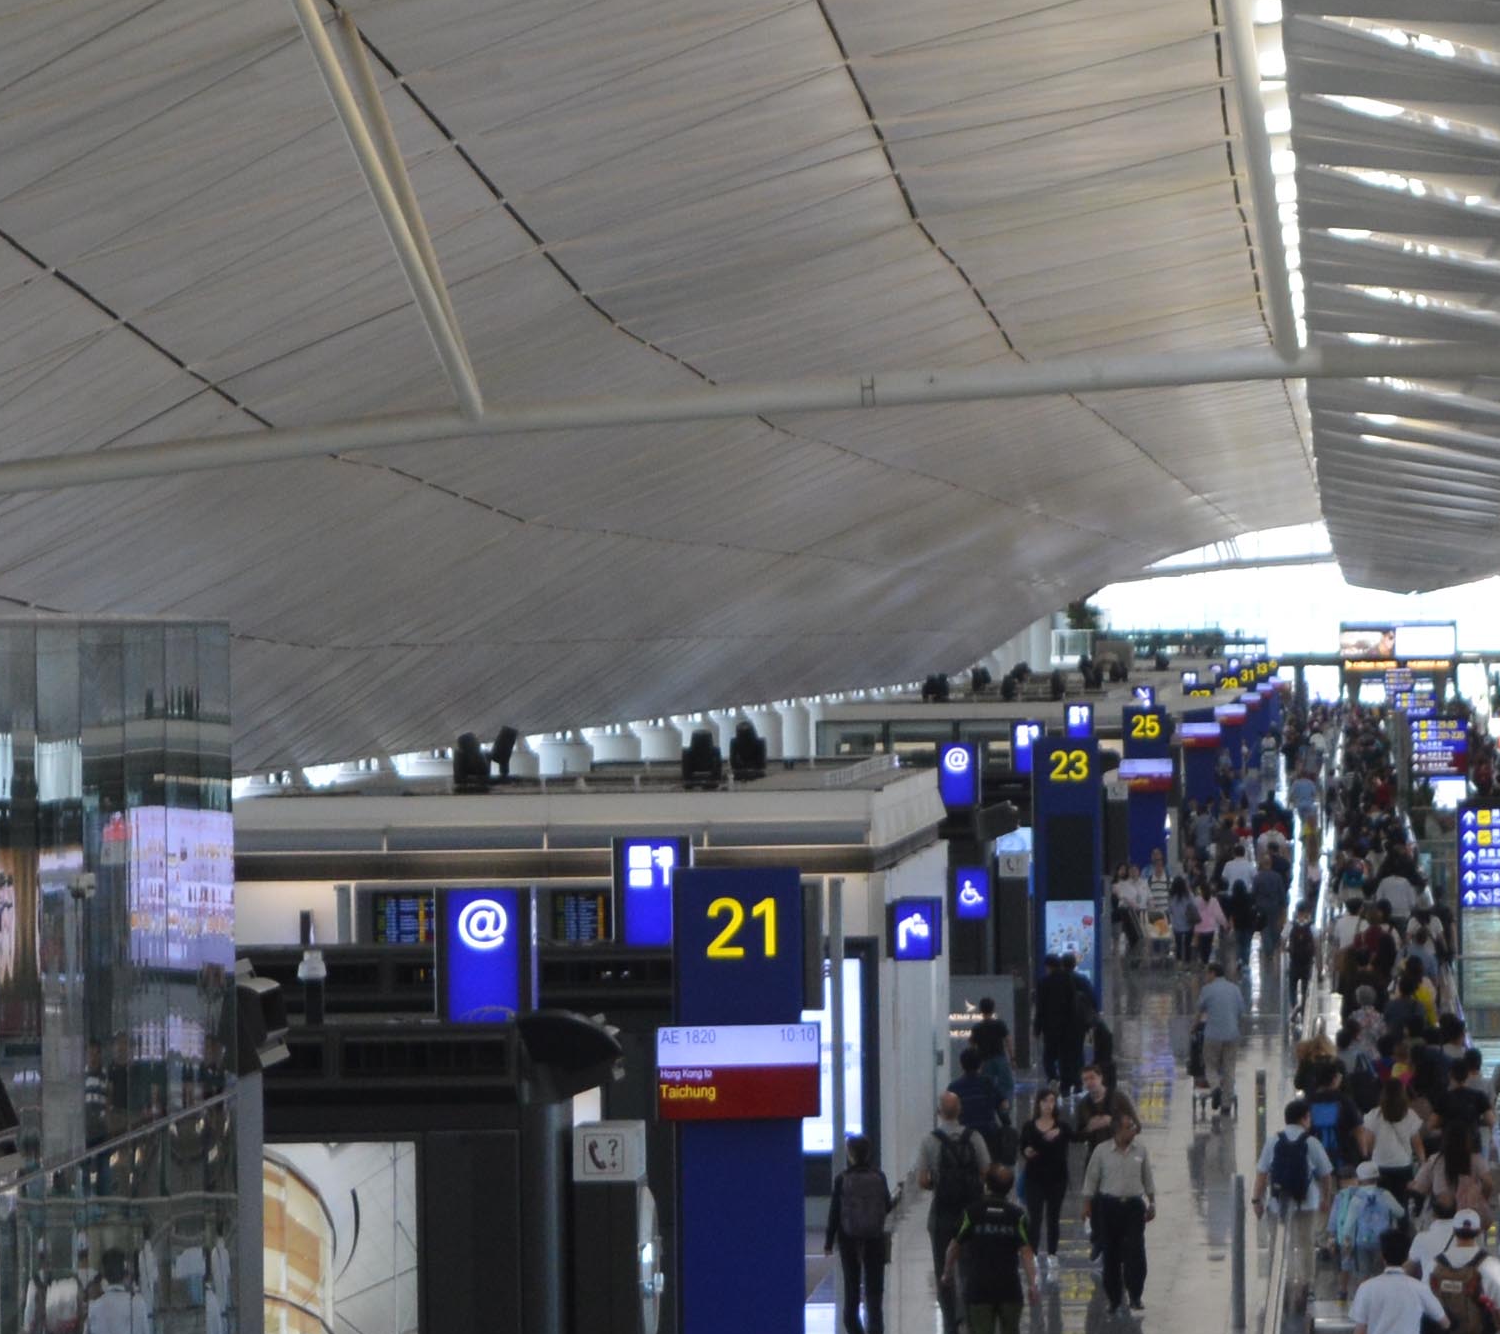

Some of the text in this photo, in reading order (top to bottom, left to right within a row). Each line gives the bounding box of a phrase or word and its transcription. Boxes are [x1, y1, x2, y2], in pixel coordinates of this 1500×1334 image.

[1240, 670, 1254, 682] 31
[1131, 714, 1160, 738] 25
[1050, 750, 1089, 781] 23
[707, 897, 776, 957] 21
[661, 1028, 815, 1044] AE 1820 10:10
[660, 1069, 681, 1081] Hong
[682, 1069, 703, 1080] Kong
[660, 1084, 716, 1101] Taichung
